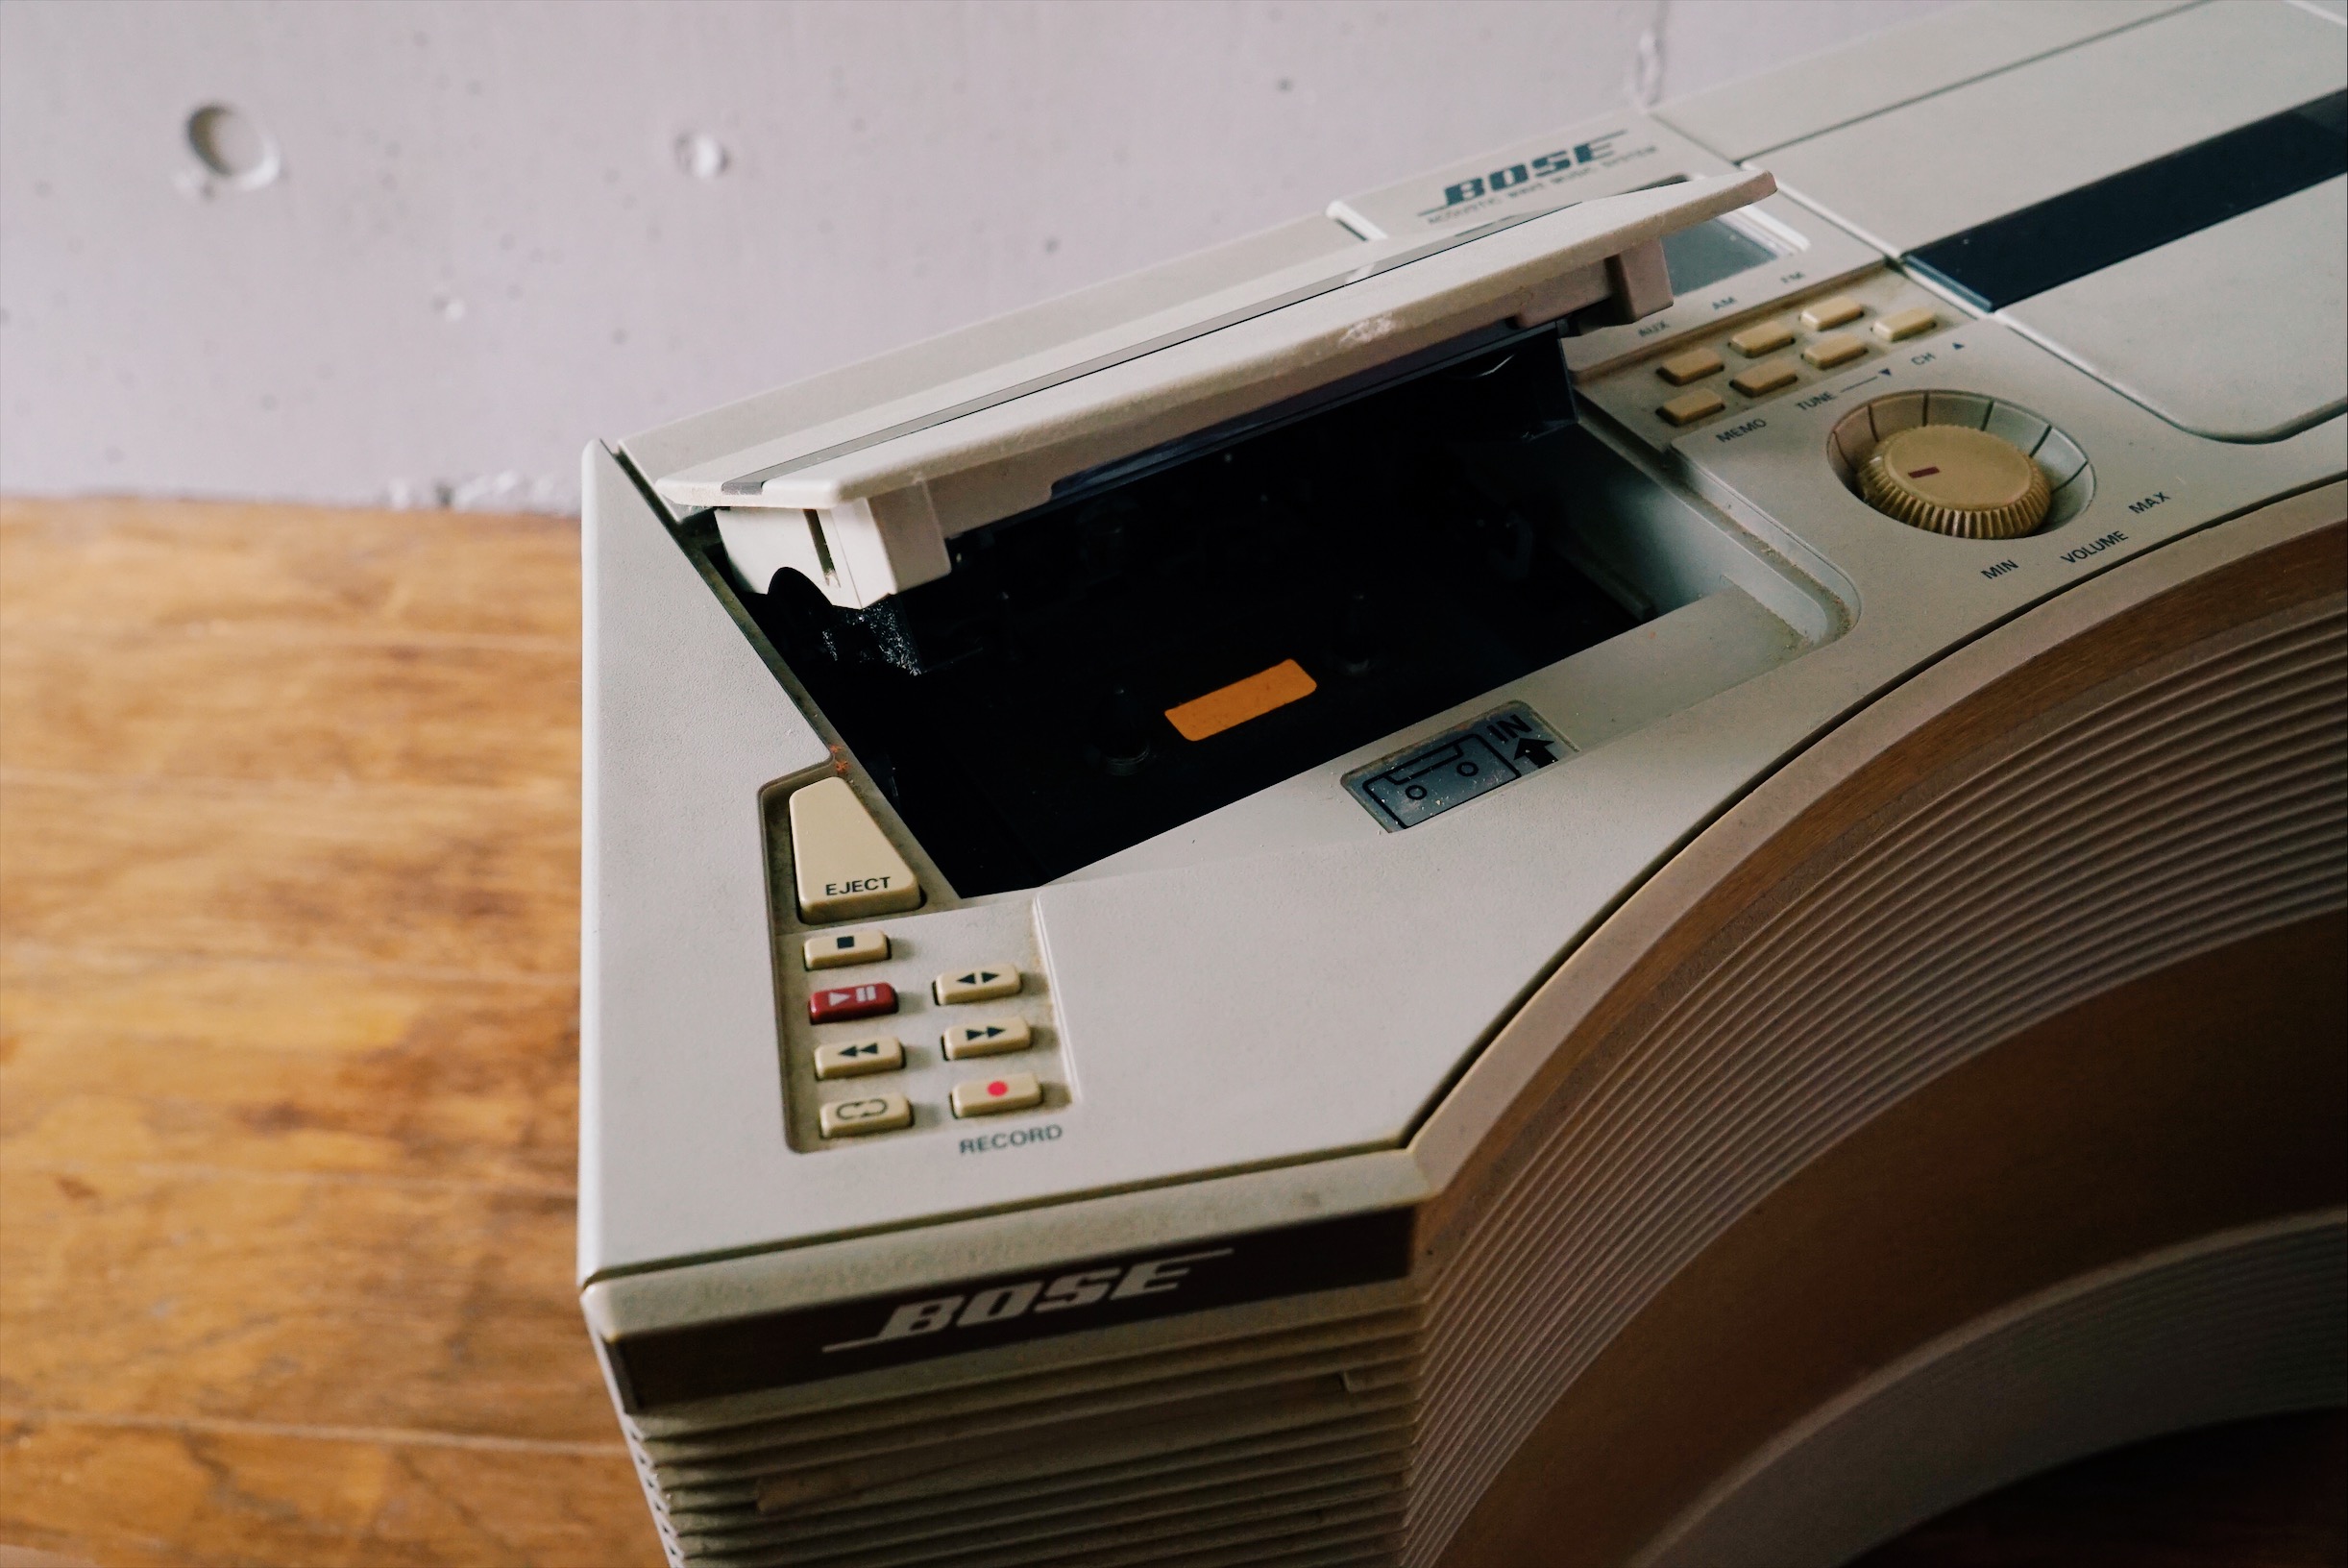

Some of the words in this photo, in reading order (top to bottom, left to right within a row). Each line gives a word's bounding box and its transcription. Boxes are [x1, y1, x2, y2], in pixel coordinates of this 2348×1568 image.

[1417, 129, 1627, 216] BOSE
[1712, 296, 1737, 310] AM
[1637, 319, 1671, 337] AUX
[1911, 353, 1936, 367] CH
[1795, 392, 1837, 410] TUNE
[1716, 418, 1768, 443] MEMO
[2128, 491, 2171, 514] MAX
[2060, 530, 2129, 564] VOLUME
[1980, 559, 2019, 579] MIN
[1486, 714, 1532, 743] IN
[825, 876, 892, 896] EJECT
[960, 1124, 1063, 1155] RECORD
[822, 1249, 1234, 1353] BOSE
